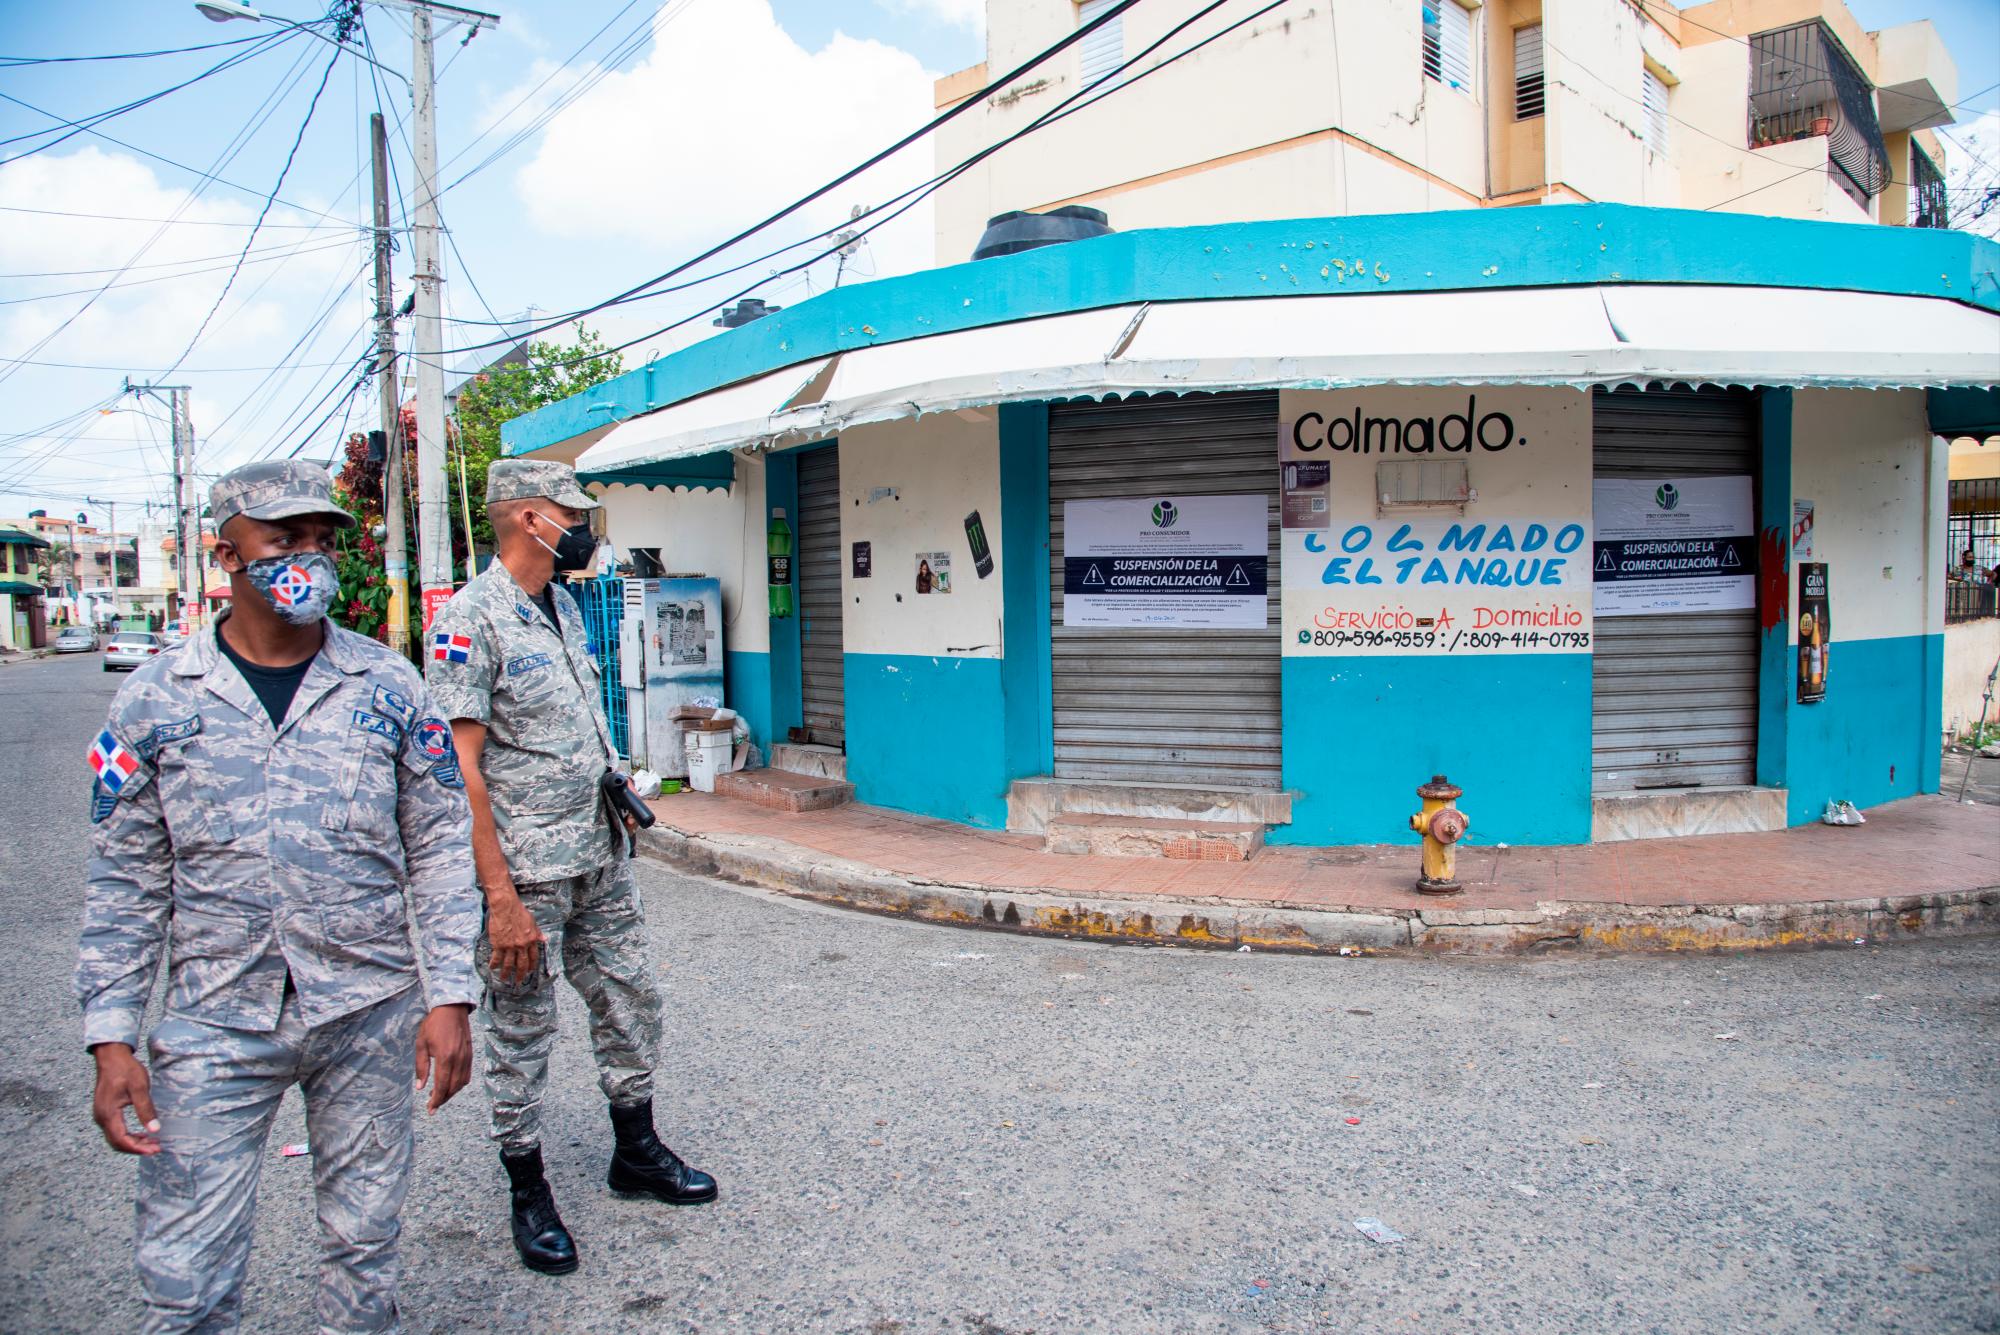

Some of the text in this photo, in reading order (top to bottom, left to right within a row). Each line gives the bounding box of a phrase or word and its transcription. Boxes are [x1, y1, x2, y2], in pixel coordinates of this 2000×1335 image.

[1623, 541, 1715, 555] SUSPENSIÓN DE LA
[1113, 558, 1218, 571] SUSPENSIÓN DE LA
[1621, 556, 1718, 571] COMERCIALIZACIÓN
[1321, 558, 1567, 587] EL TANQUE
[1110, 574, 1222, 586] COMERCIALIZACIÓN
[1806, 575, 1824, 587] GRAN
[1805, 587, 1825, 596] MODELO
[431, 594, 450, 602] TAXI
